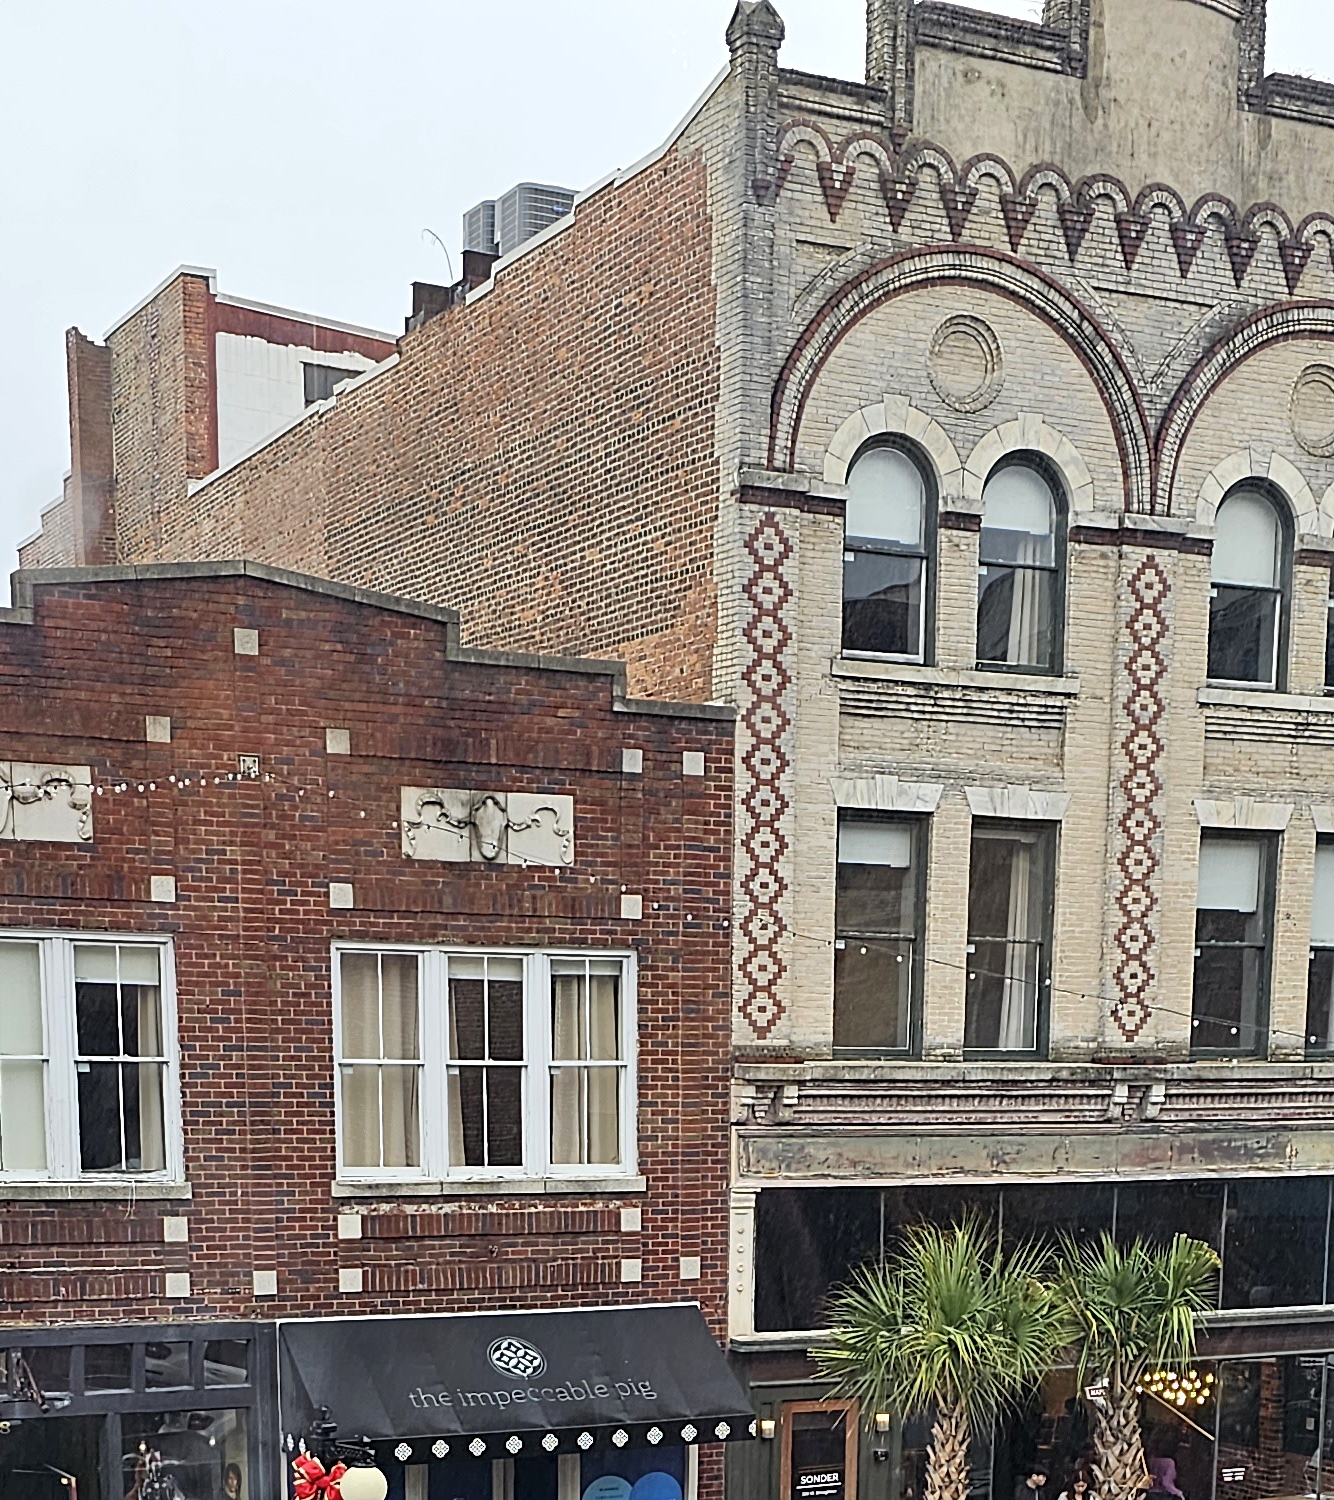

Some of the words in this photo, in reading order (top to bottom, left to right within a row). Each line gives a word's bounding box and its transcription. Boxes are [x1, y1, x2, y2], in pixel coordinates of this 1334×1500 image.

[409, 1387, 452, 1408] the
[456, 1379, 610, 1410] impeccable
[614, 1378, 657, 1400] pig
[800, 1472, 839, 1484] SONDER
